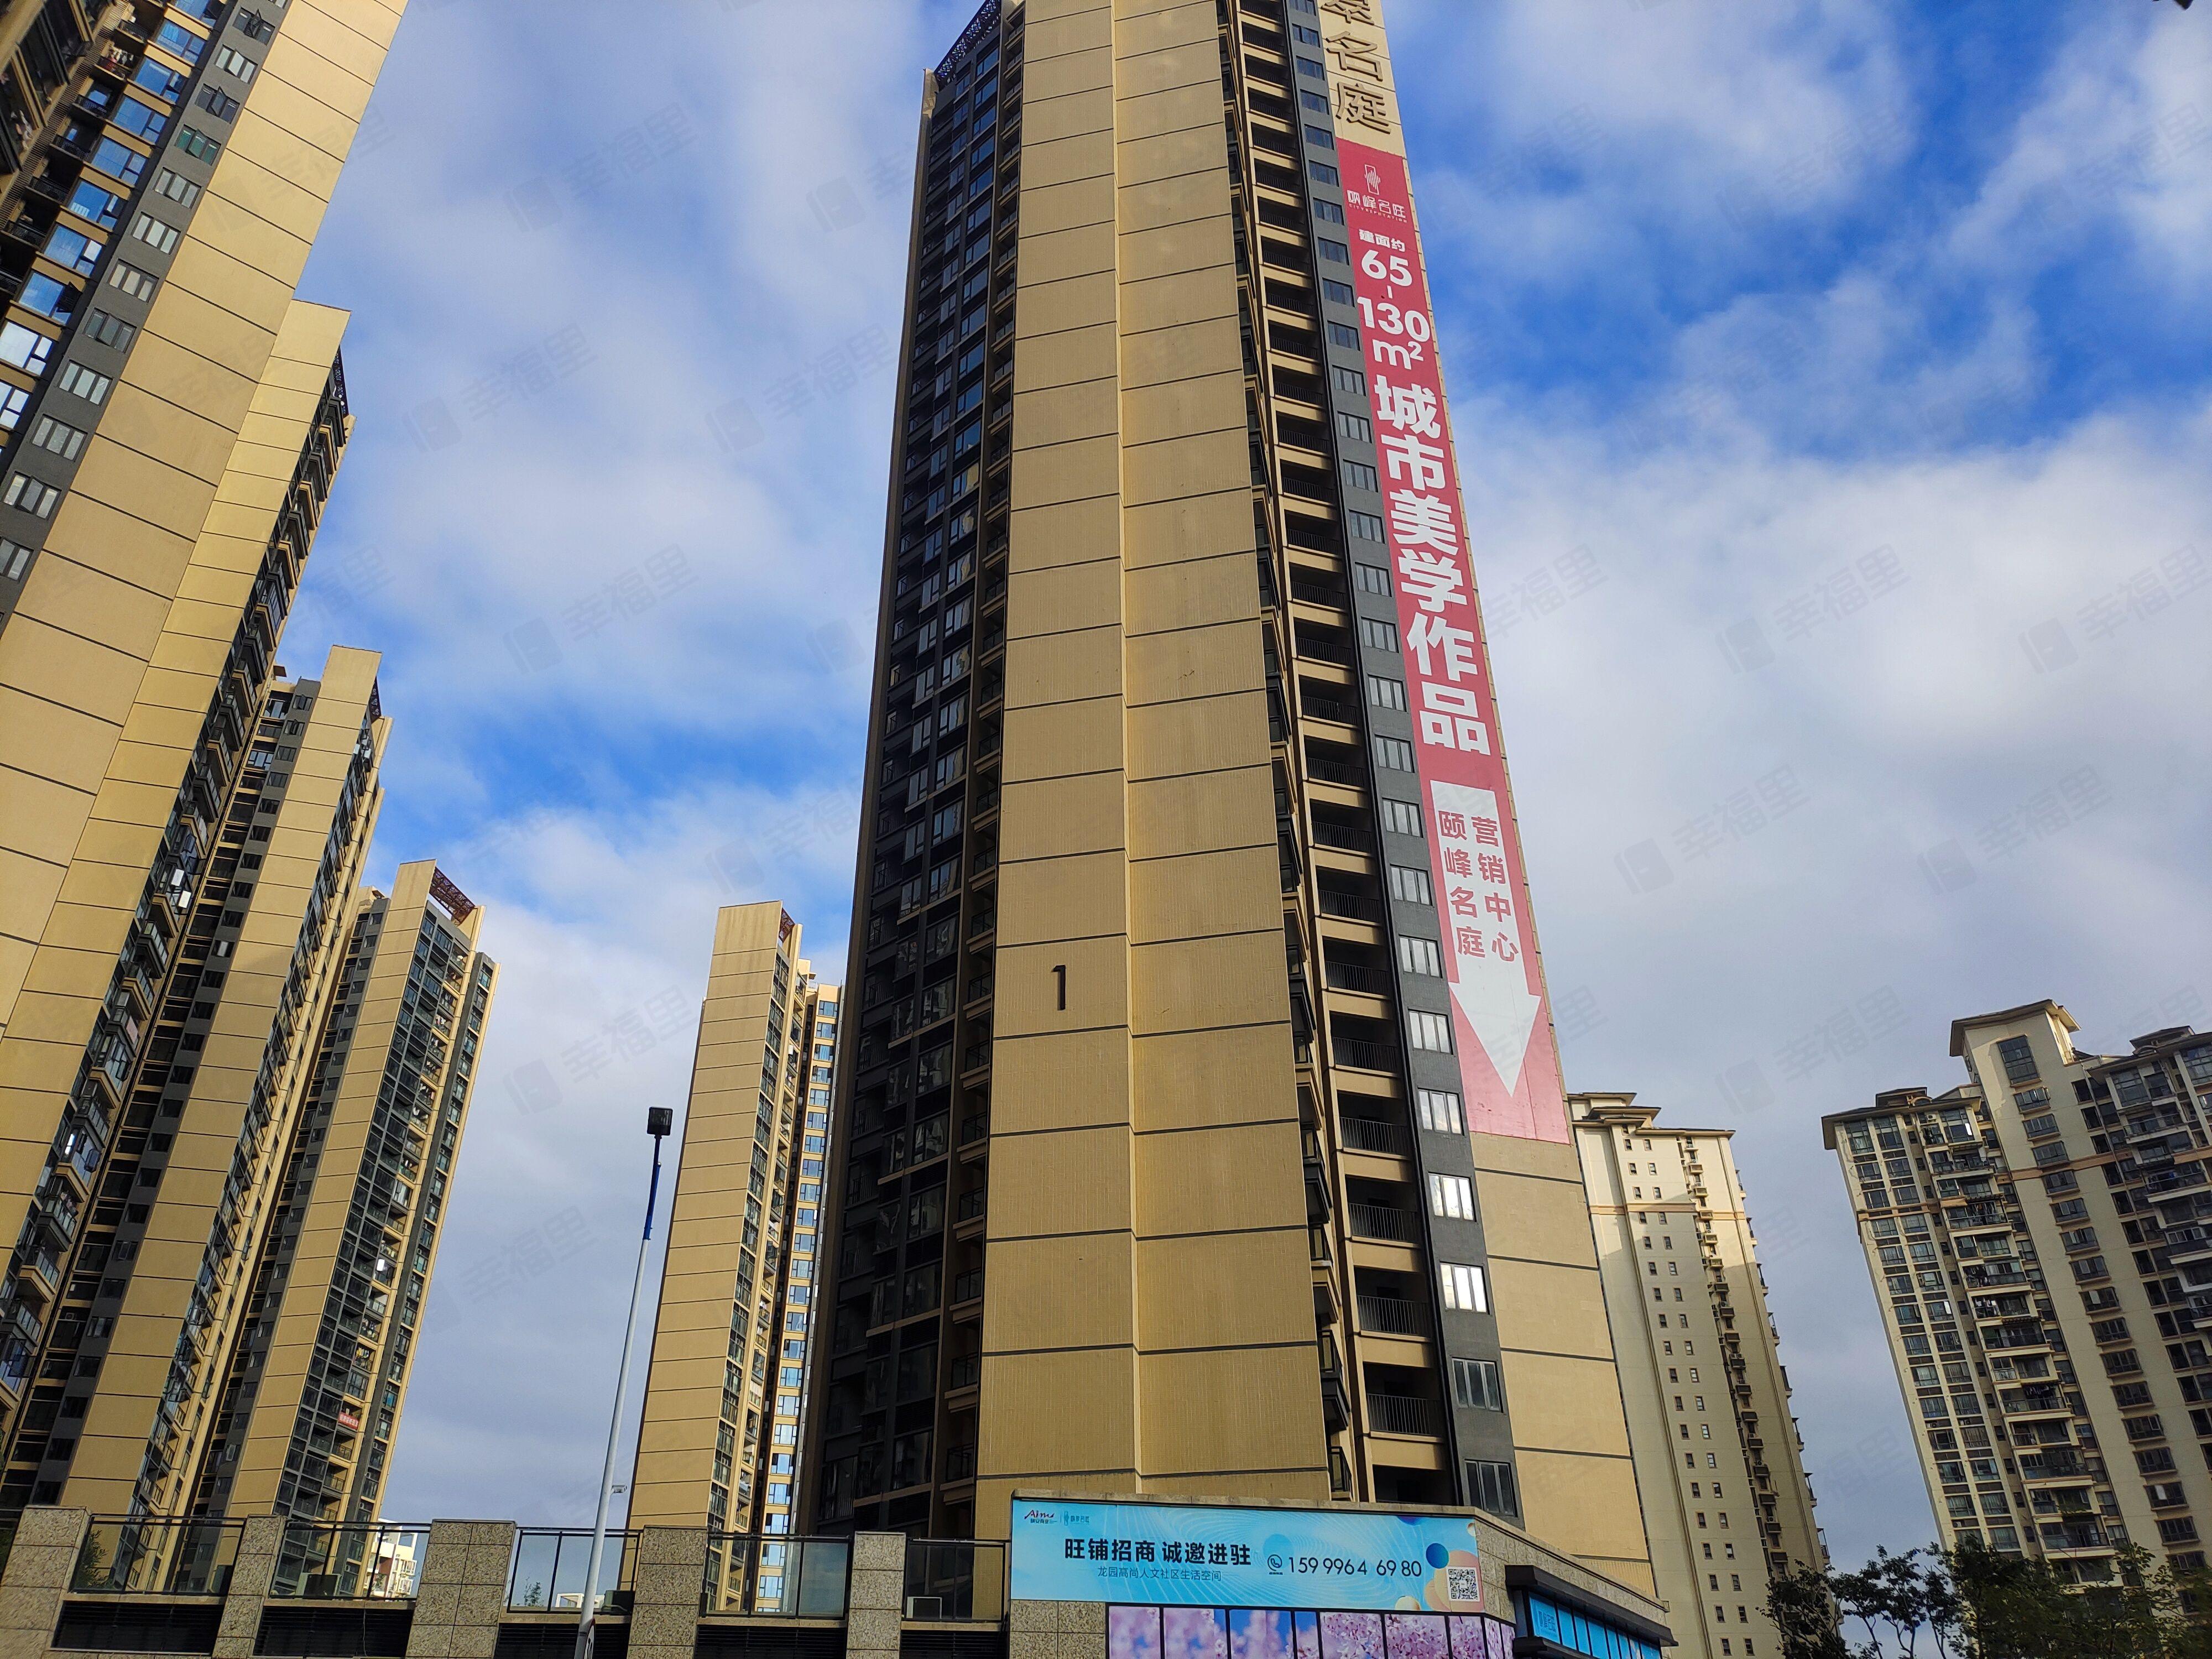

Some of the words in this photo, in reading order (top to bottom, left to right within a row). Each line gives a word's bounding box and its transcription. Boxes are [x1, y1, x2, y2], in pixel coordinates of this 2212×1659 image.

[1359, 229, 1405, 252] 建面约
[1361, 250, 1412, 287] 65
[1357, 297, 1430, 342] 130
[1374, 374, 1491, 756] 城市美学作品
[1438, 810, 1486, 959] 颐峰名庭
[1472, 816, 1519, 962] 营销中心
[1051, 964, 1066, 1011] 1
[1065, 1538, 1155, 1562] 旺铺招商
[1162, 1541, 1251, 1566] 诚邀进驻
[1098, 1566, 1221, 1582] 龙园高尚人文社区生活空间
